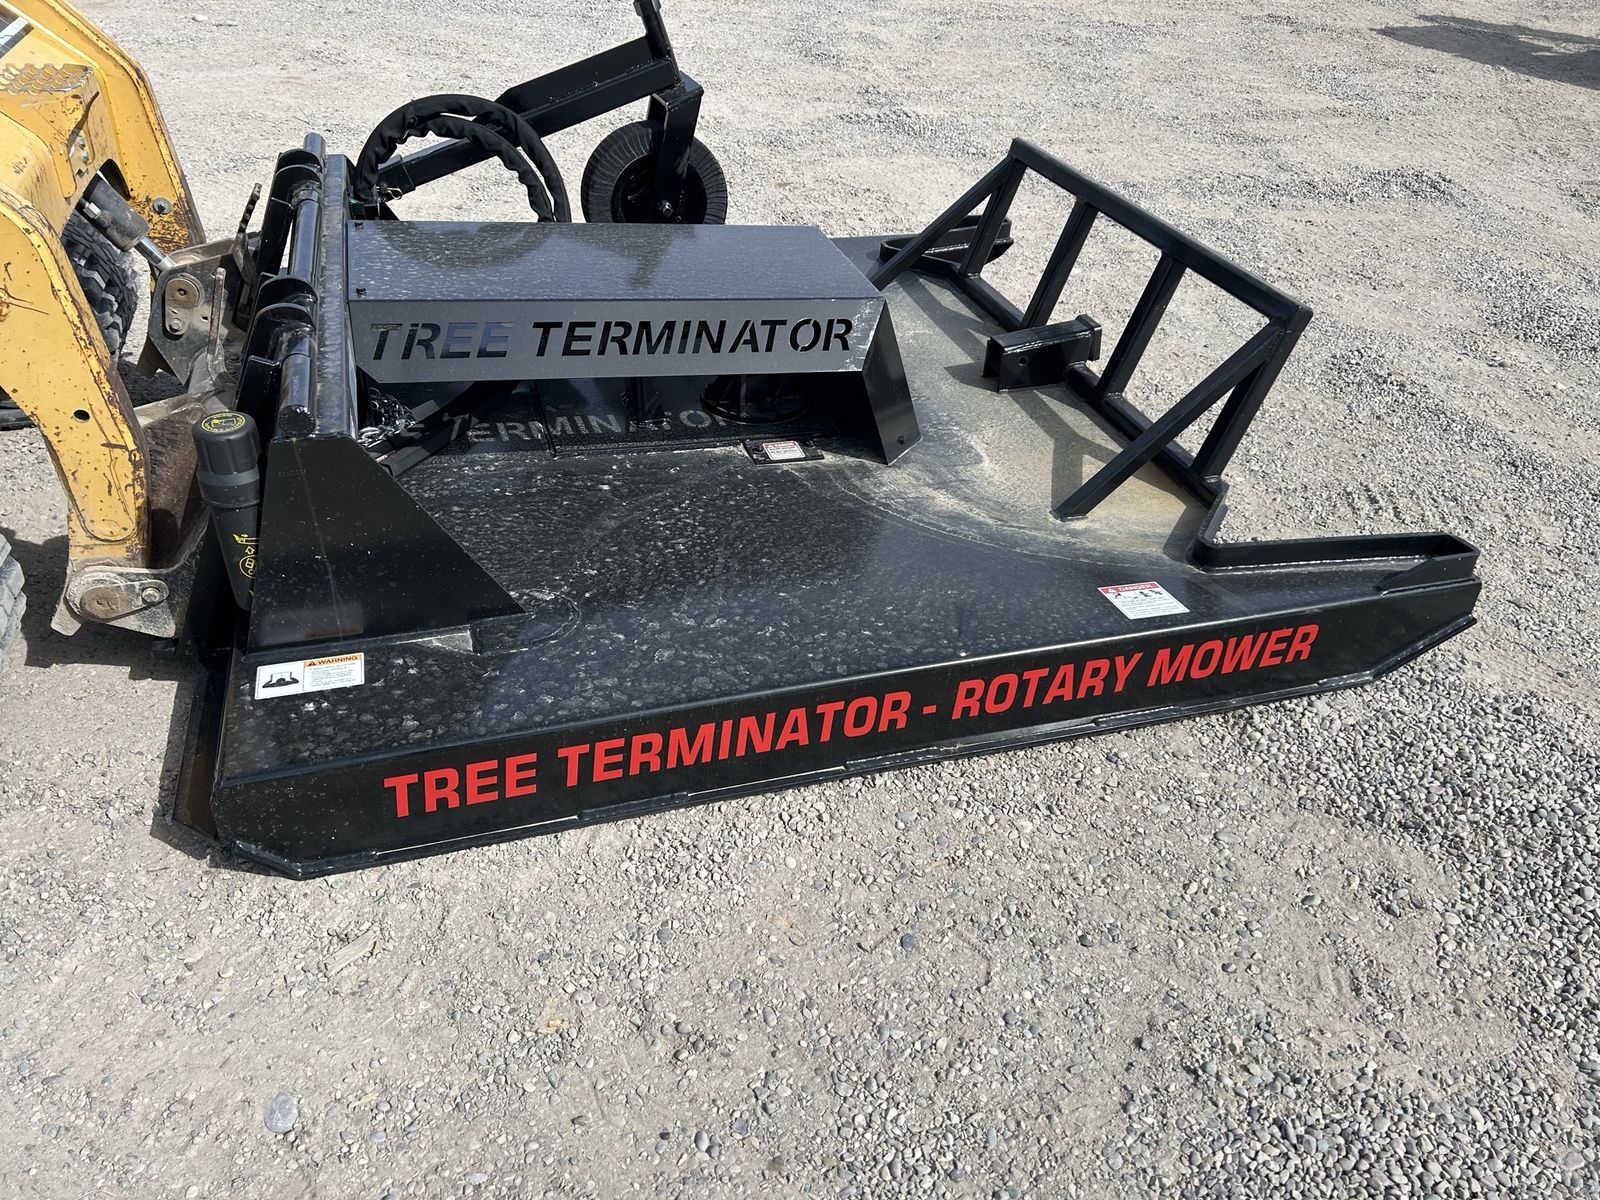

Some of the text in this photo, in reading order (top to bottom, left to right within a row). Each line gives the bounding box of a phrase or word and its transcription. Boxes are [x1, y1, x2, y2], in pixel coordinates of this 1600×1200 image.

[370, 318, 853, 360] TREE TERMINATOR
[1119, 584, 1152, 592] DANGER
[317, 655, 358, 665] WARNING
[384, 625, 1319, 816] TREE TERMINATOR - ROTARY MOWER
